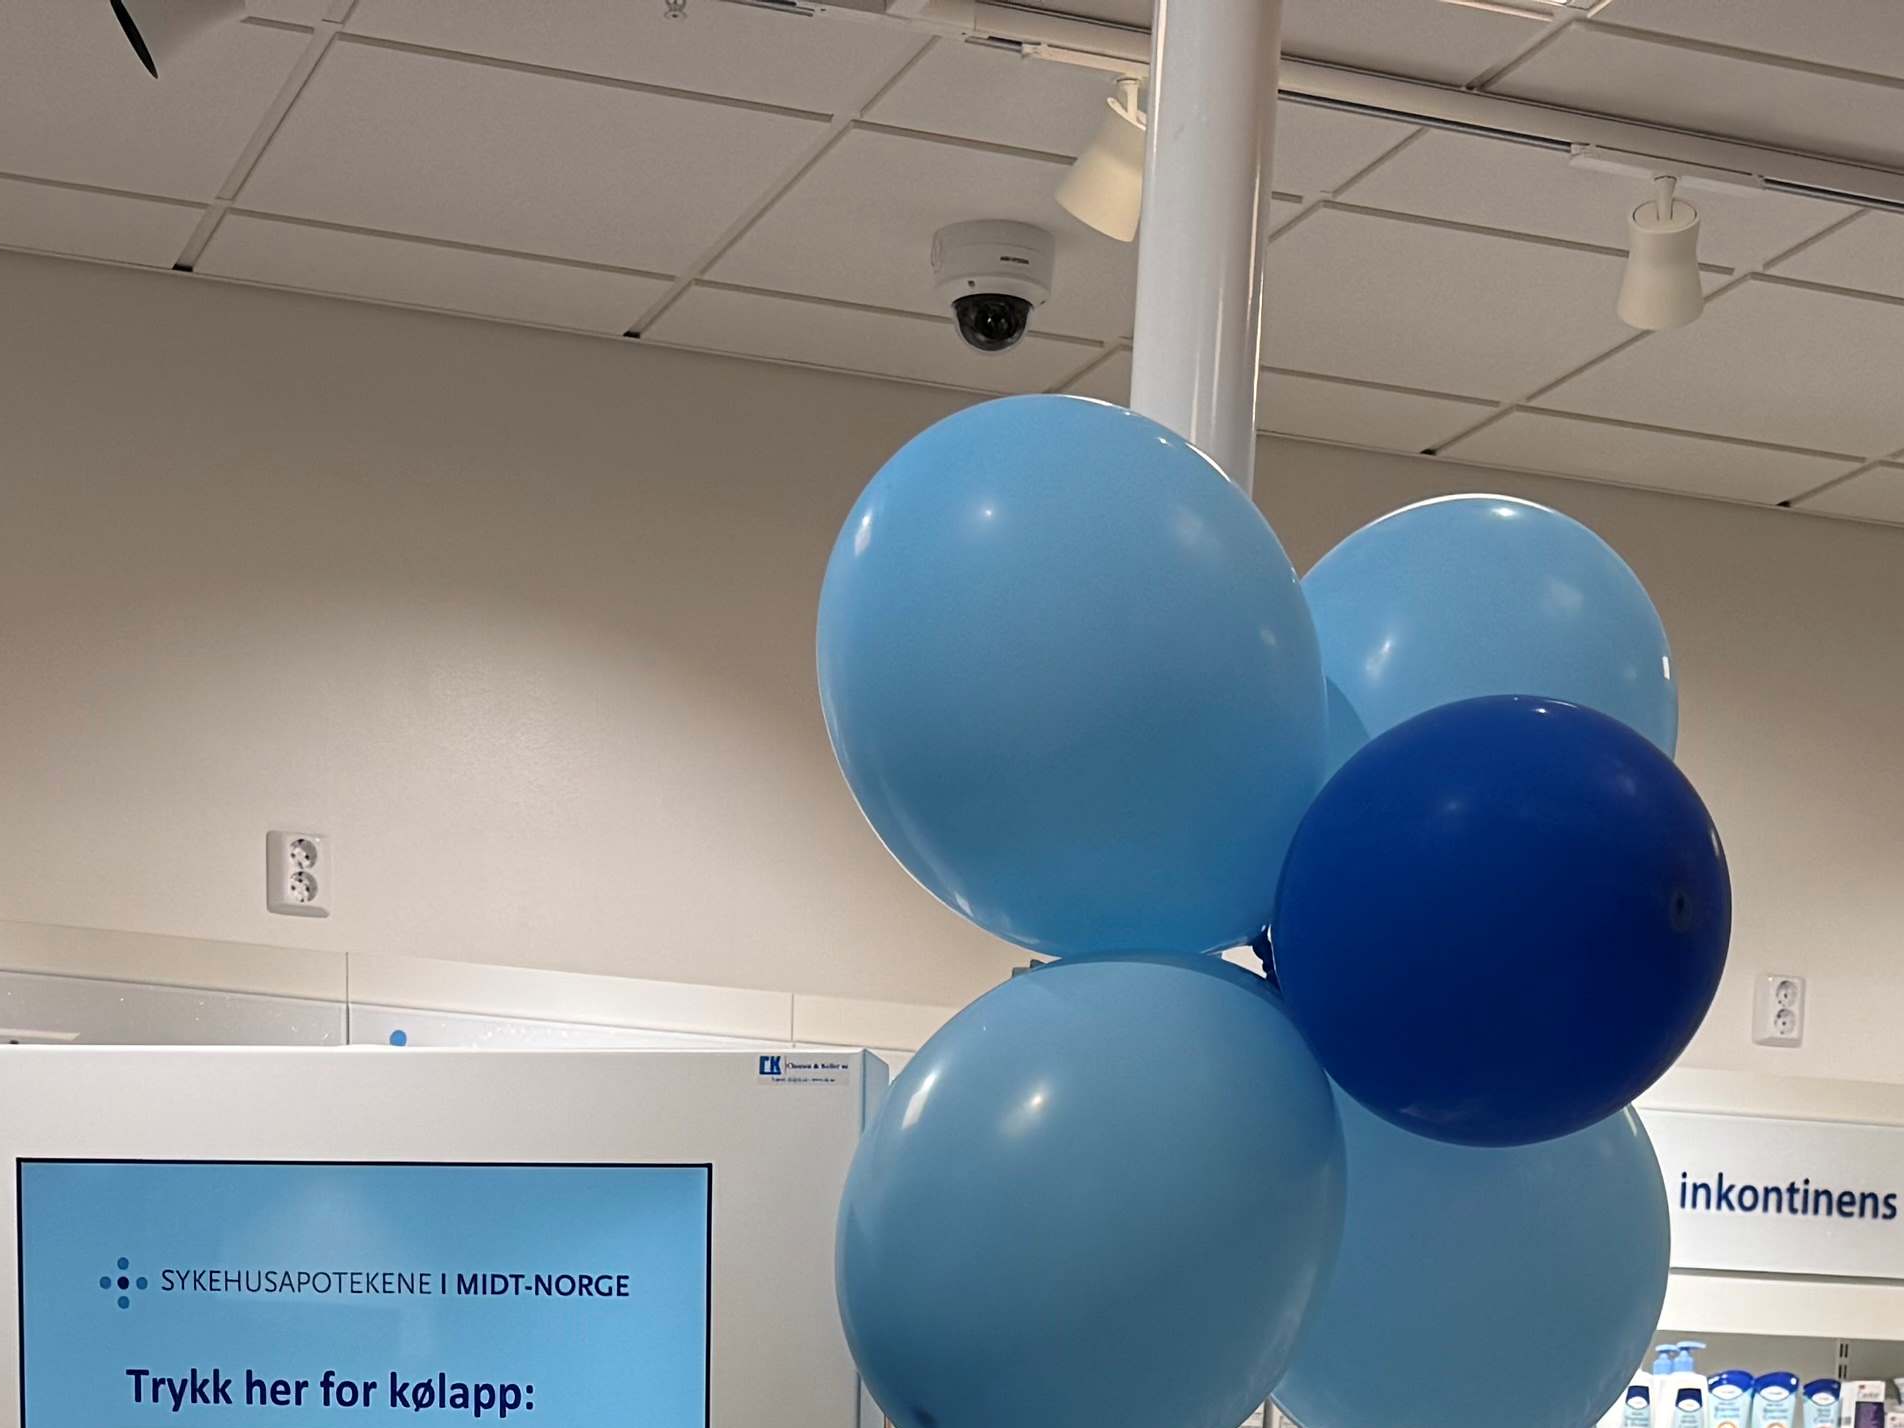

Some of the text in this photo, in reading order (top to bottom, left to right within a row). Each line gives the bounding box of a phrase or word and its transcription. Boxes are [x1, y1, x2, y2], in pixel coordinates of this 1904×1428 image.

[1678, 1171, 1897, 1222] inkontinens
[160, 1267, 431, 1296] SYKEHUSAPOTEKENE
[456, 1273, 630, 1298] MIDT-NORGE
[126, 1368, 536, 1418] Trykk her for kølapp:
